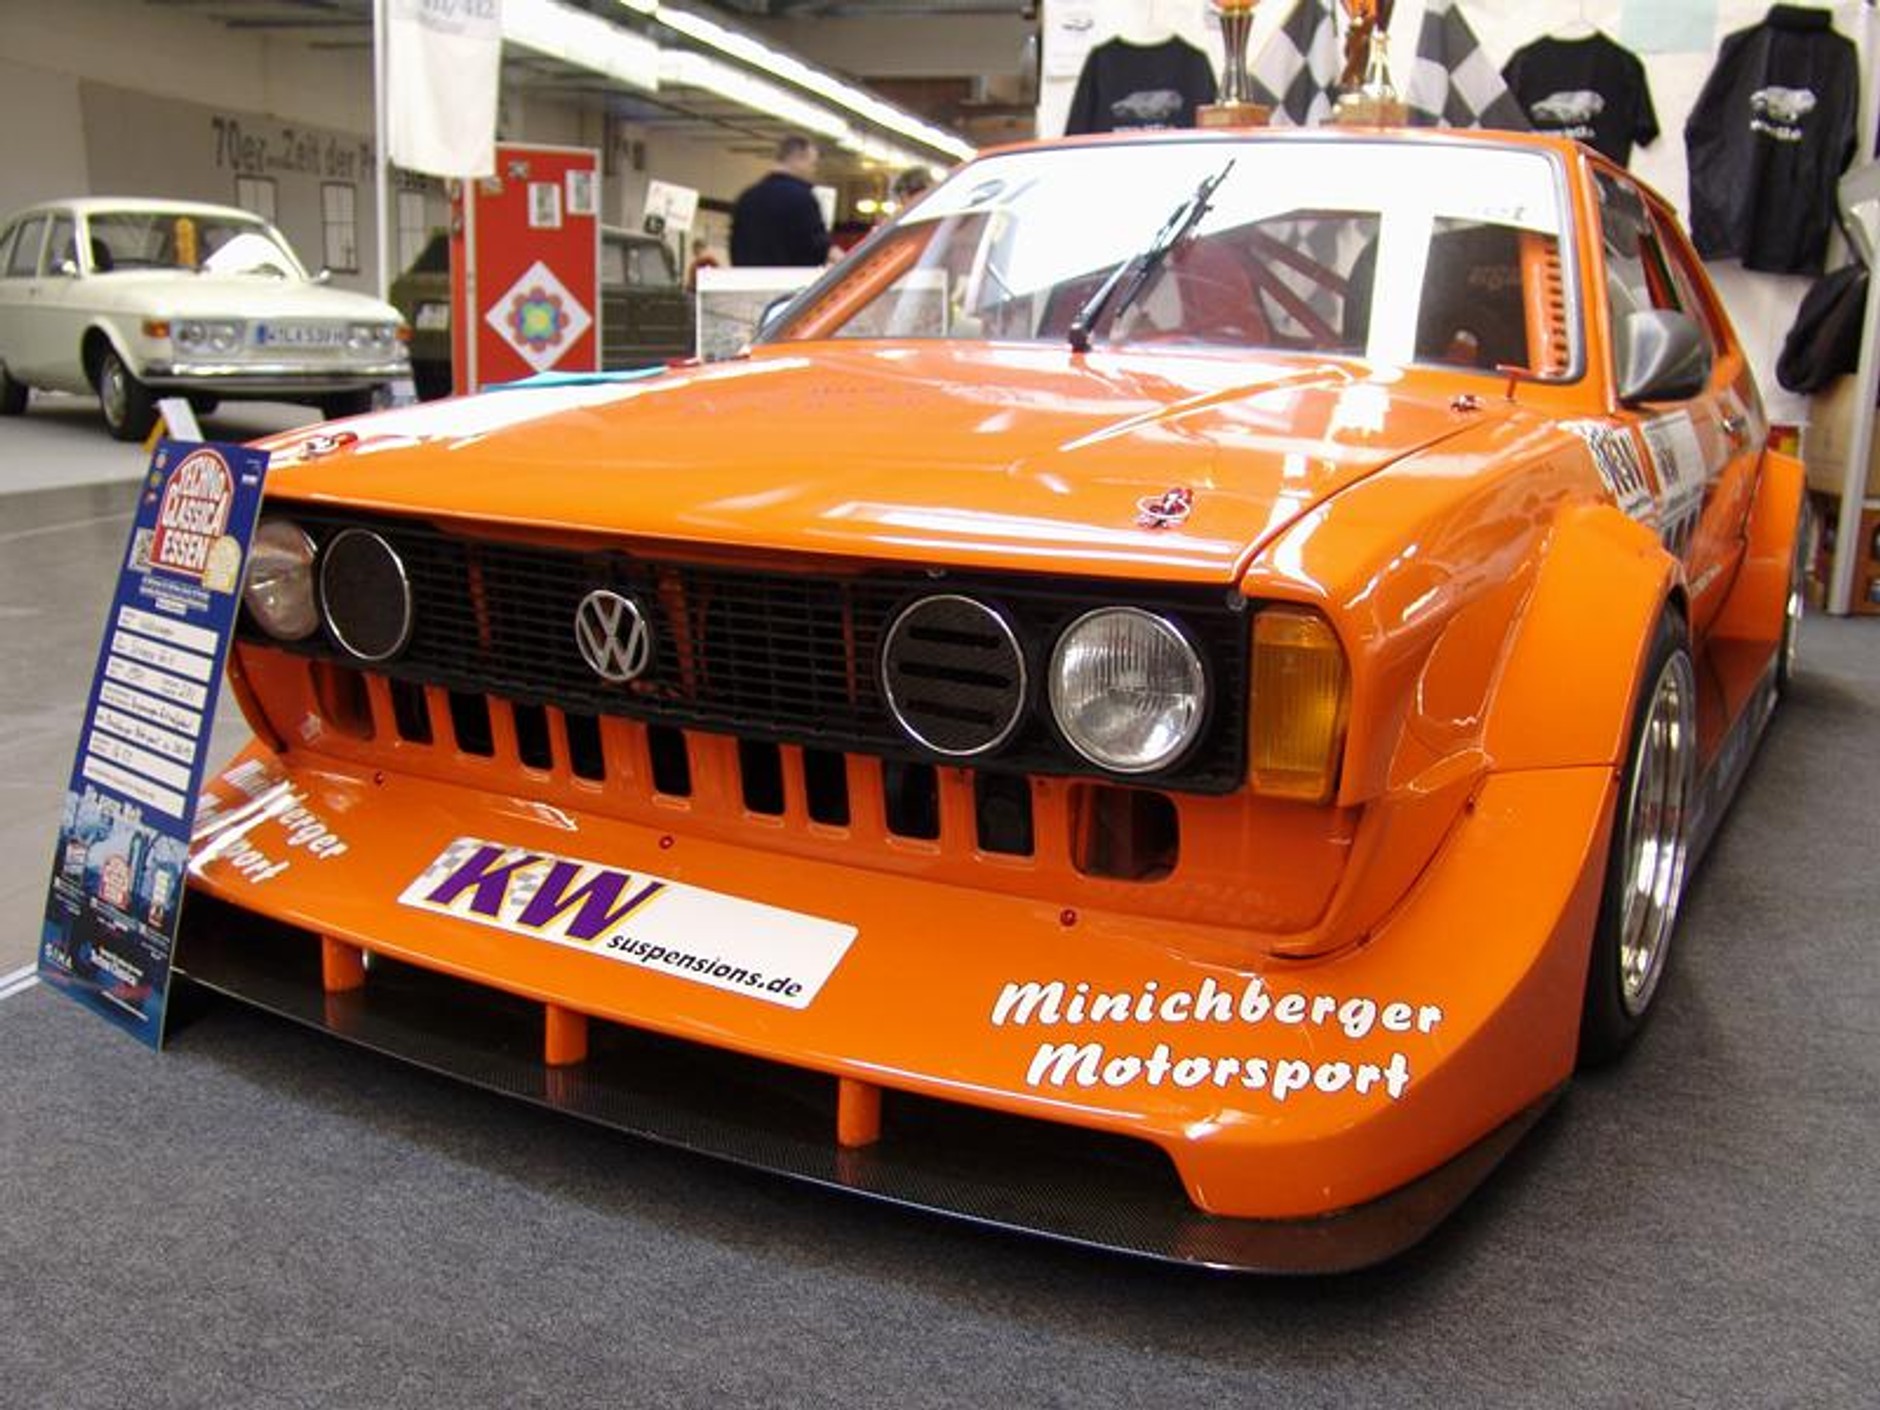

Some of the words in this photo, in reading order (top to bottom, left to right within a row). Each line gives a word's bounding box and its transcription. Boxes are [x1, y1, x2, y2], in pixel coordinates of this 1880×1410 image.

[162, 483, 230, 538] CLASSICA
[159, 526, 212, 573] ESSEN
[576, 592, 646, 680] VW
[427, 845, 665, 942] KW
[607, 933, 803, 998] suspensions.de
[990, 977, 1443, 1038] Minichberger
[1024, 1043, 1410, 1101] Motorsport
